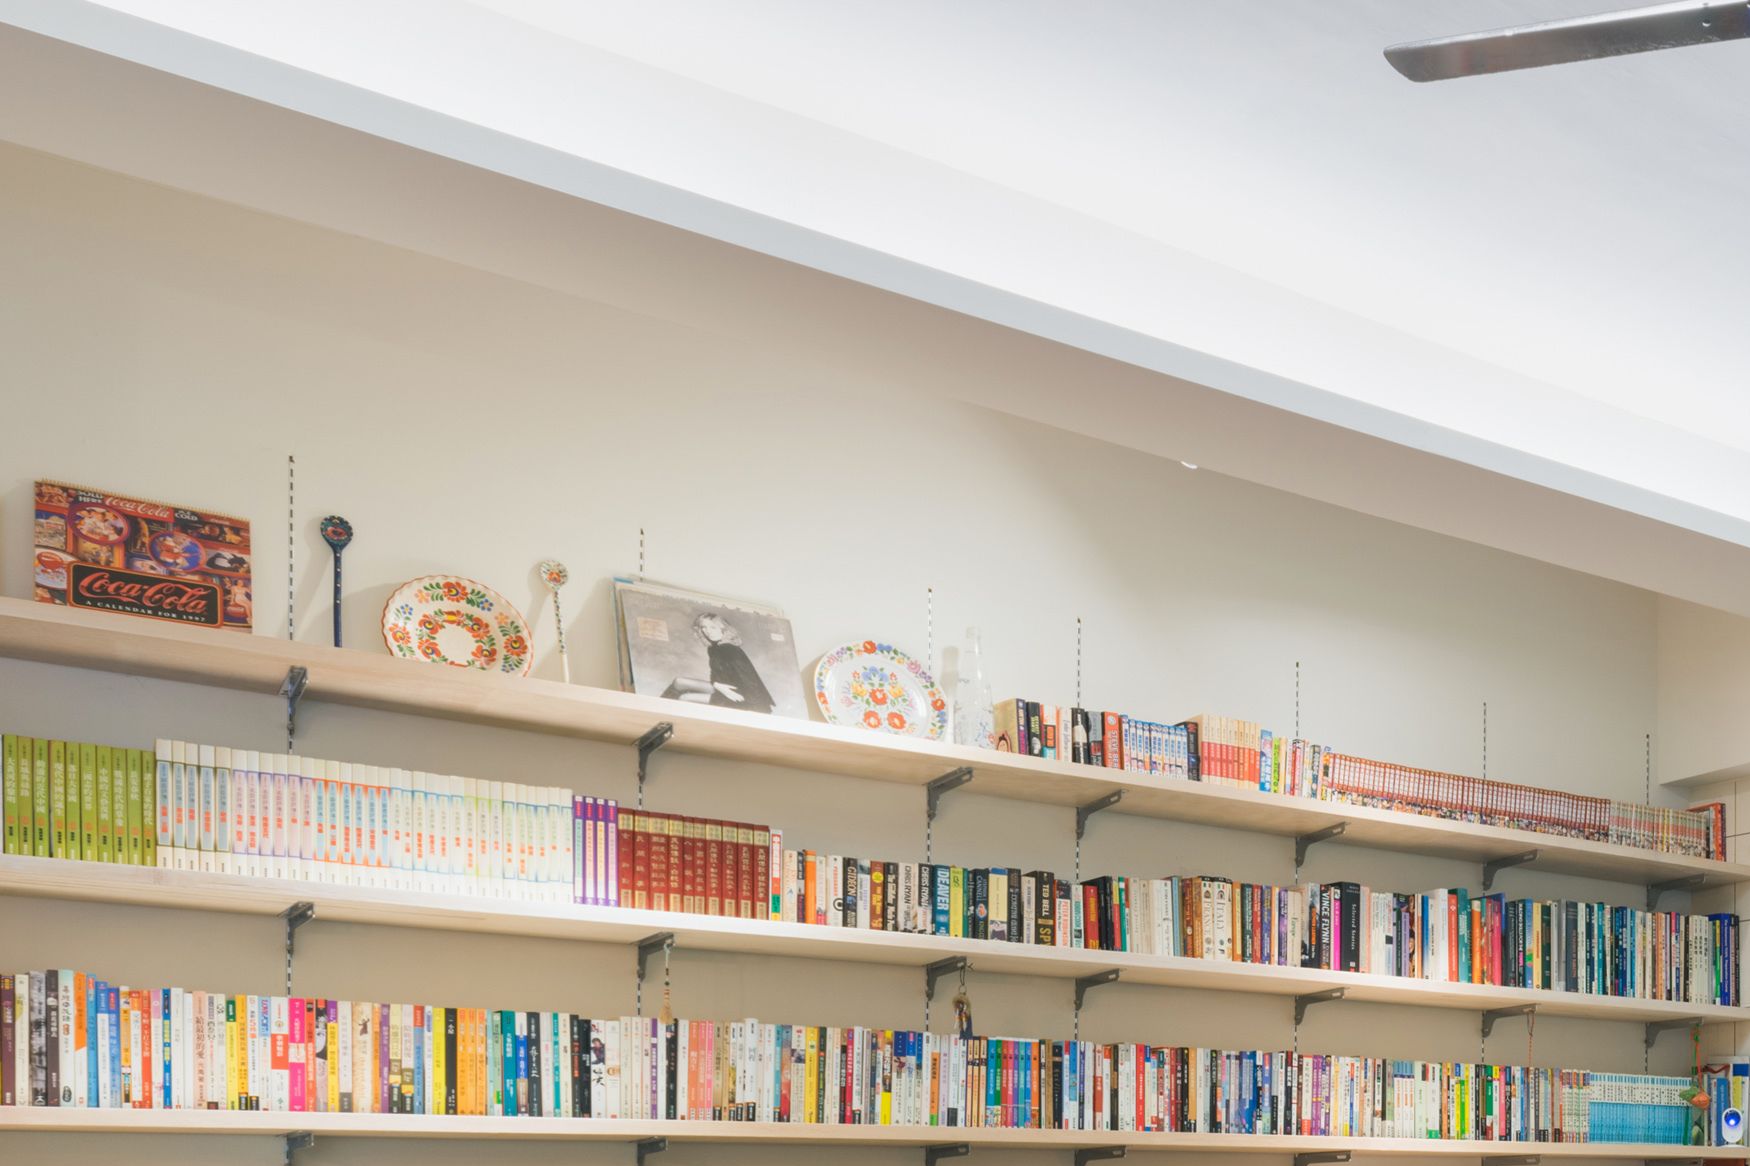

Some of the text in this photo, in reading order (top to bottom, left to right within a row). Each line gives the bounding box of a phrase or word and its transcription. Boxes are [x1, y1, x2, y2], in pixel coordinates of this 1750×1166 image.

[97, 602, 152, 616] CALENDAR
[158, 610, 177, 619] FOR
[847, 866, 857, 896] GIDEON
[903, 885, 912, 904] RYAN
[937, 871, 949, 910] DEAVER
[1041, 884, 1050, 917] TED BELL
[1321, 892, 1331, 943] VINCE FLYNN
